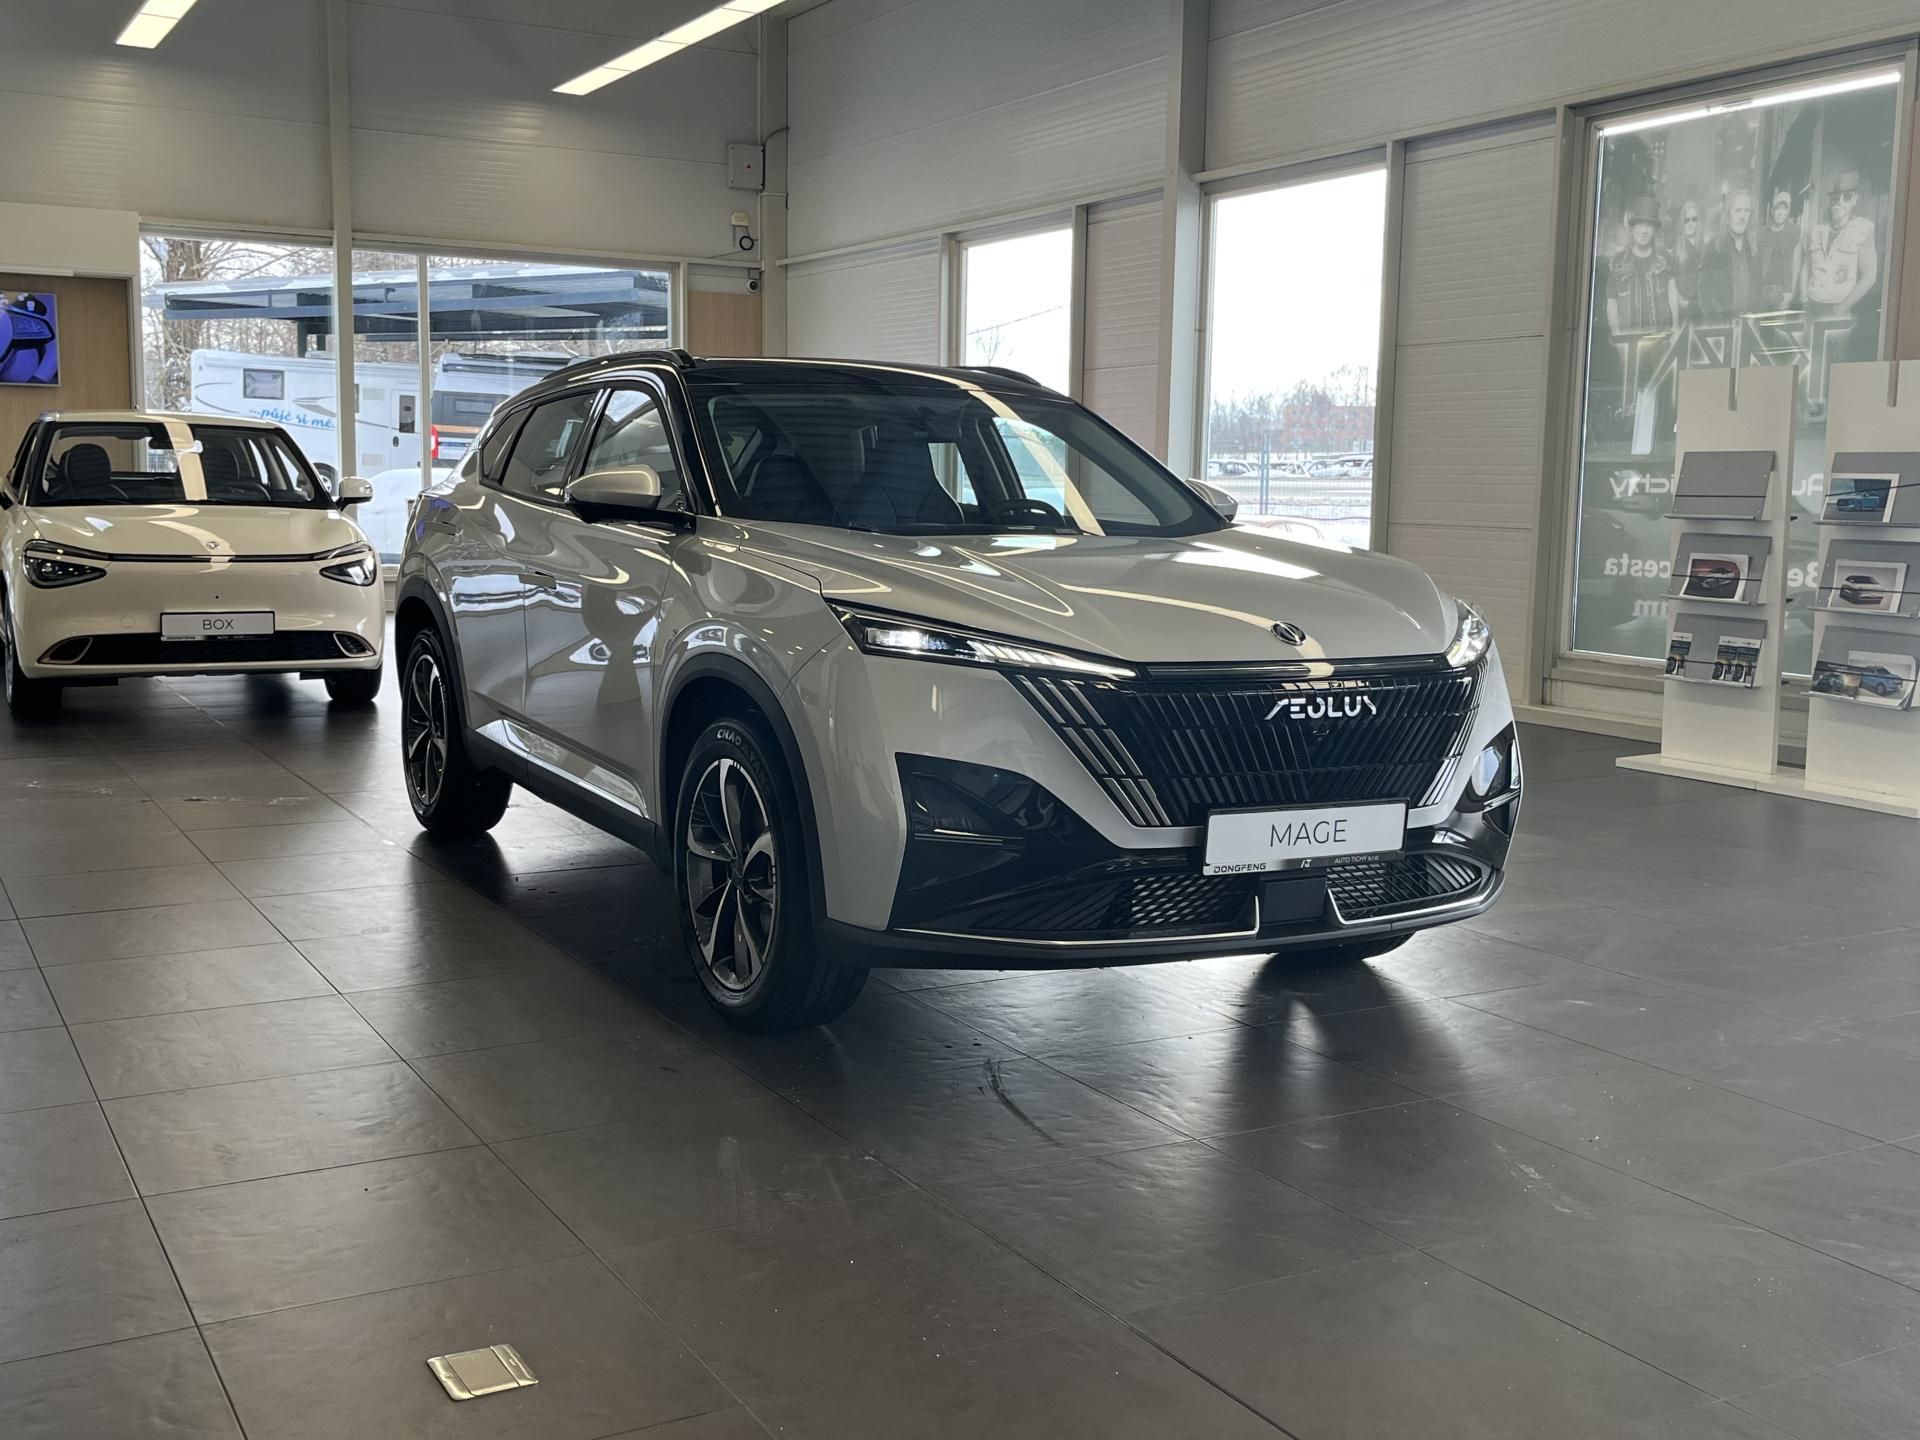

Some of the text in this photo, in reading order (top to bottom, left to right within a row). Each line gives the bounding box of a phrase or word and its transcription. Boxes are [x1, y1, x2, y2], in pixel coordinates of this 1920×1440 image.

[202, 618, 234, 631] BOX
[1264, 695, 1377, 720] AEOLUS
[1269, 819, 1348, 847] MAGE
[1334, 856, 1350, 864] AUTO
[1213, 863, 1267, 873] DONGFENG
